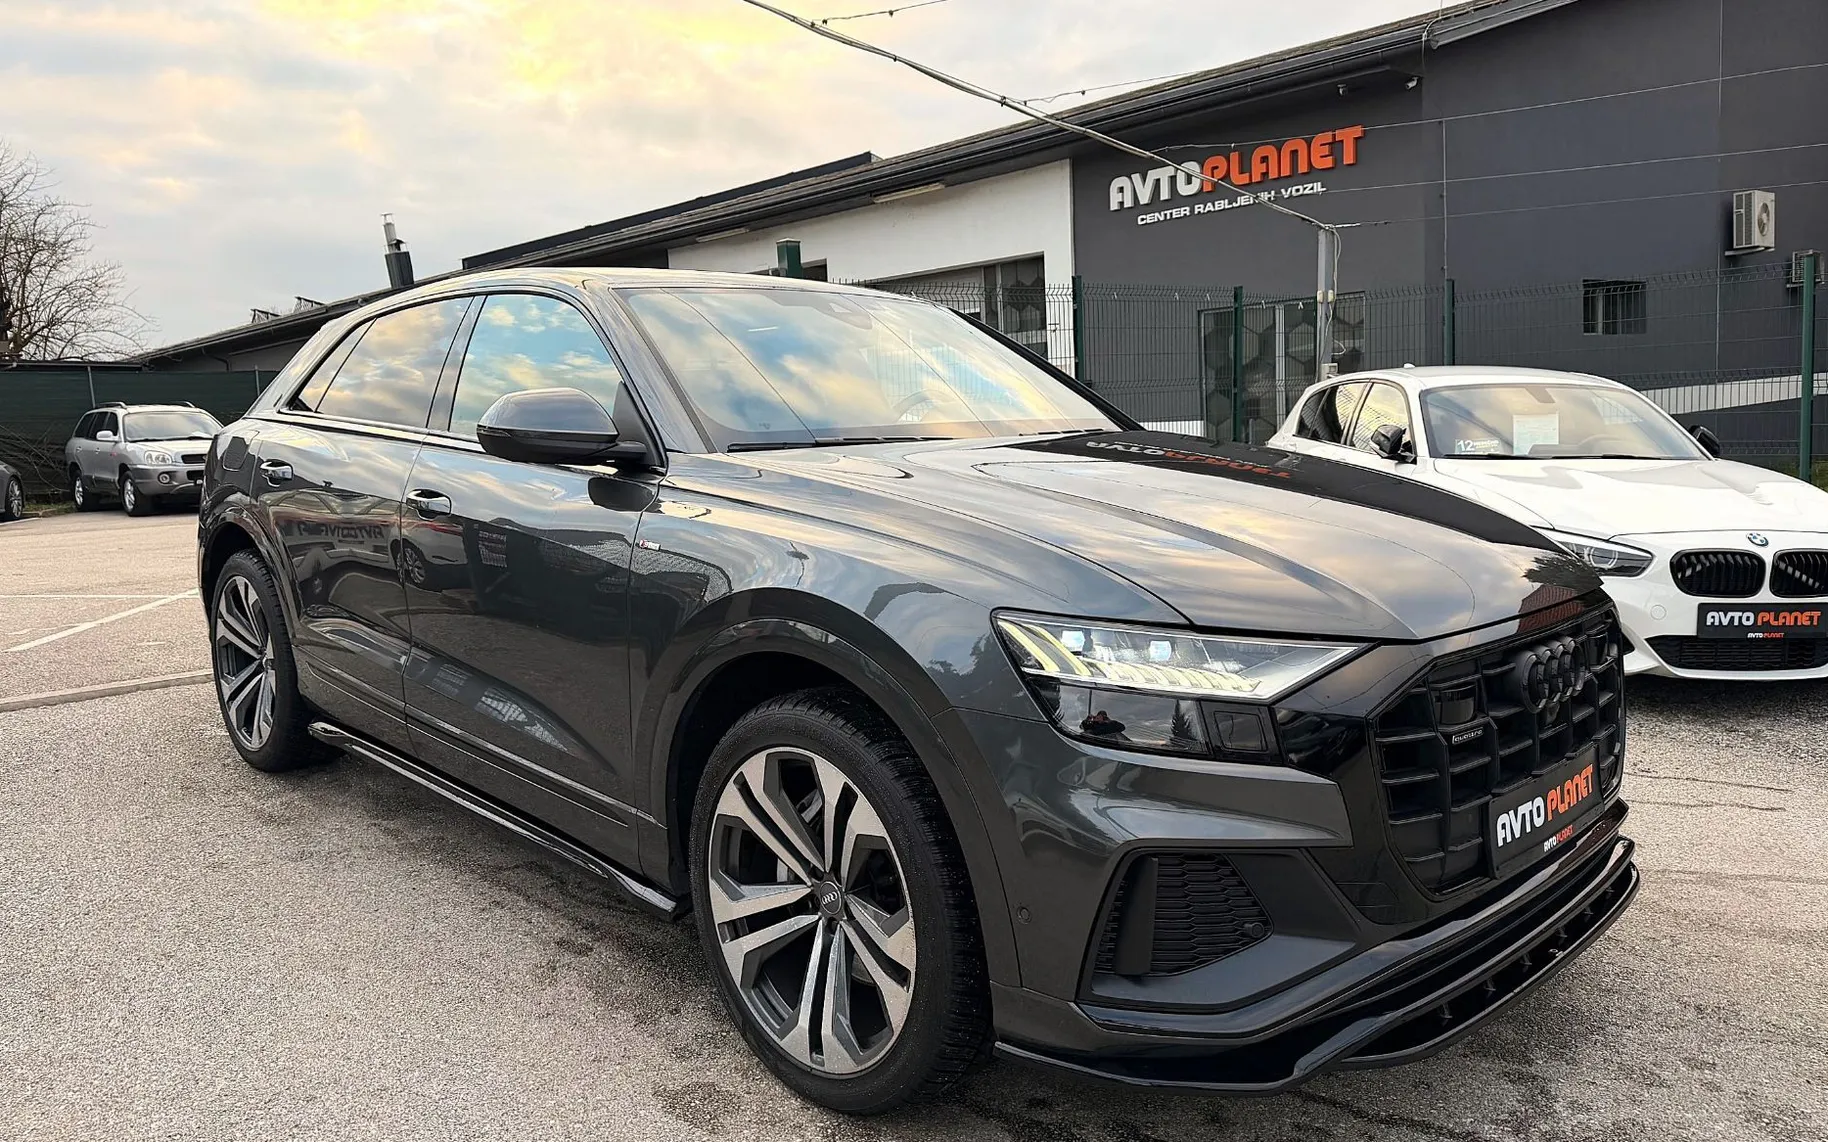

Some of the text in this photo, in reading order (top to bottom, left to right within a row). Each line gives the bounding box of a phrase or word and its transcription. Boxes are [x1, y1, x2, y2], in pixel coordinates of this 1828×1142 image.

[1137, 182, 1327, 225] CENTER RABLJENIH VOZIL
[1457, 440, 1475, 451] 12
[1705, 611, 1821, 626] AVTO PLANET
[1496, 764, 1593, 847] AVTO PLANET
